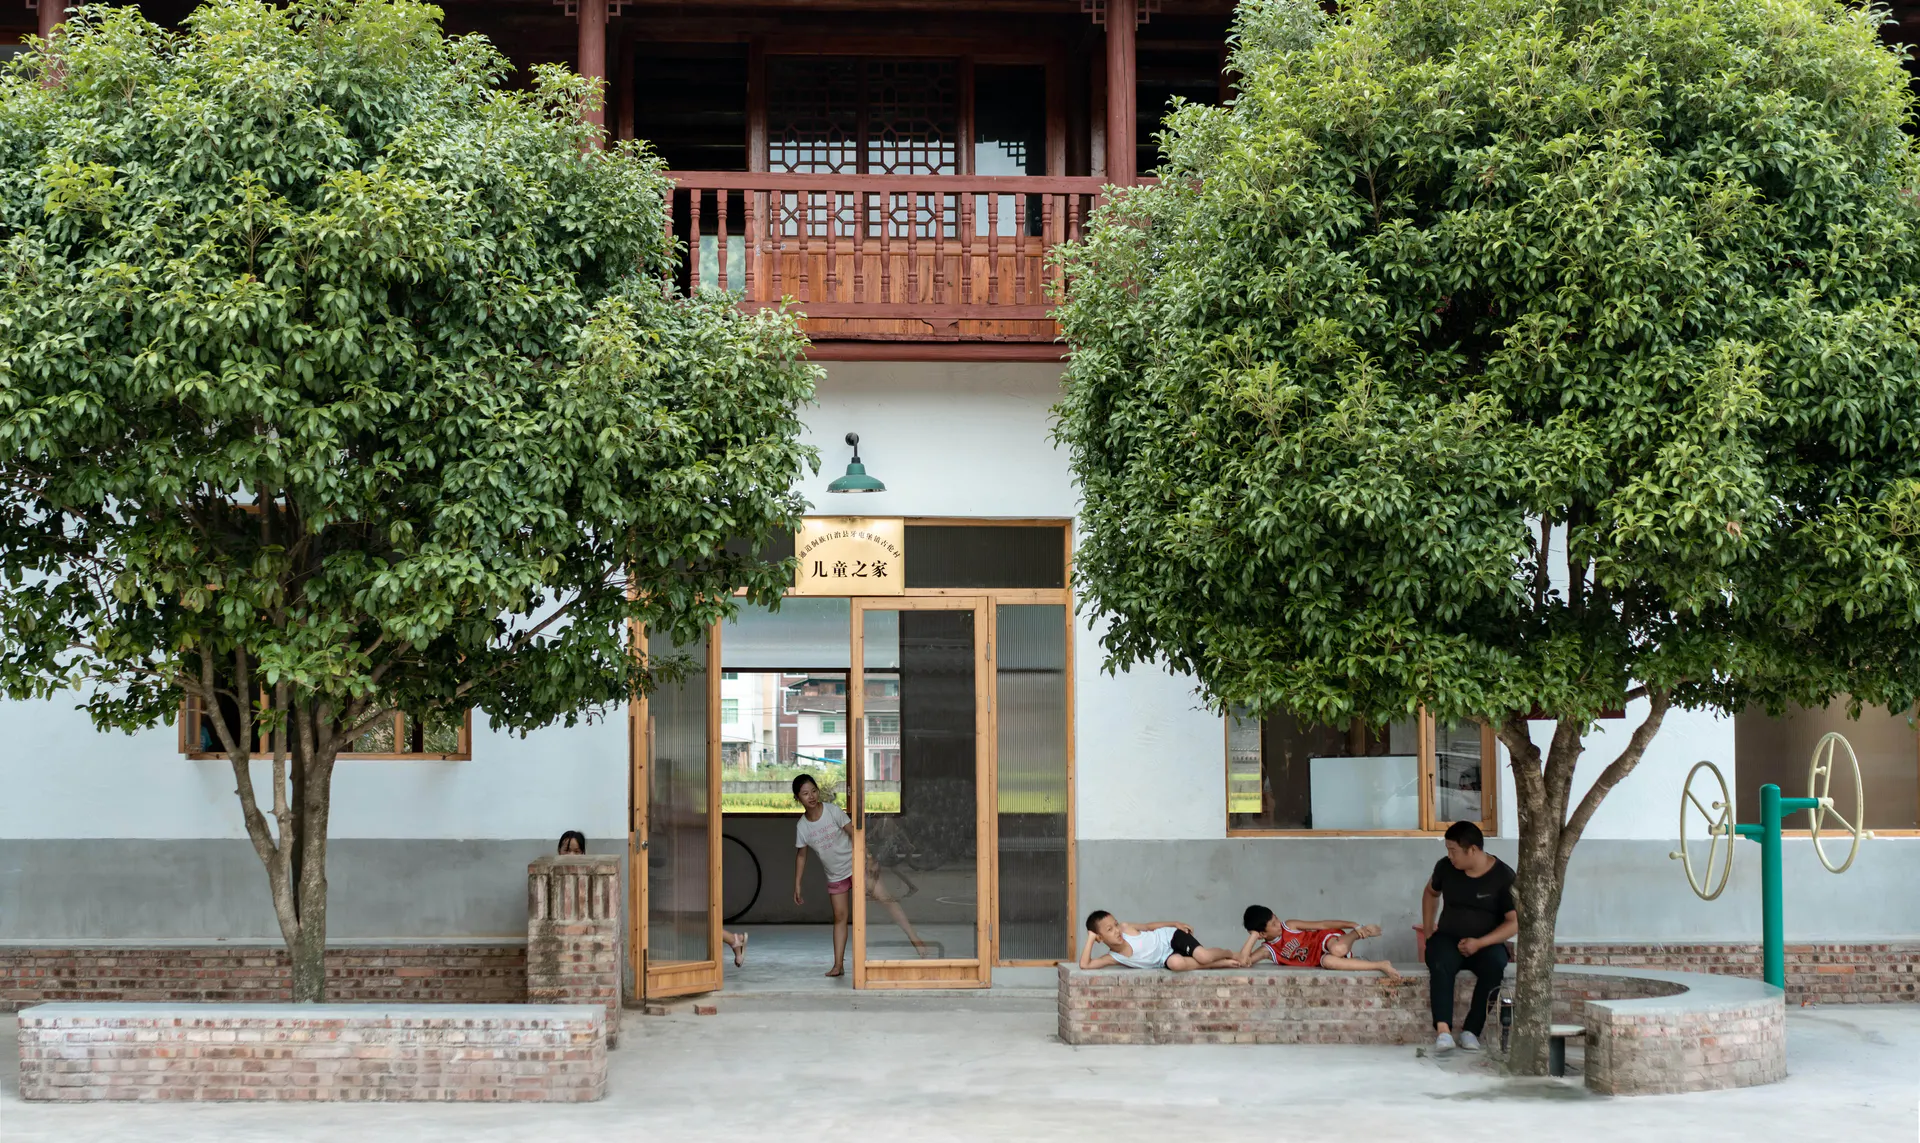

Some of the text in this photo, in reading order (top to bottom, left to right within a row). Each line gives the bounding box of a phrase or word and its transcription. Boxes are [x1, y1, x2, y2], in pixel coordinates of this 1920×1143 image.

[811, 560, 888, 578] 儿童之家
[1293, 947, 1308, 963] 23
